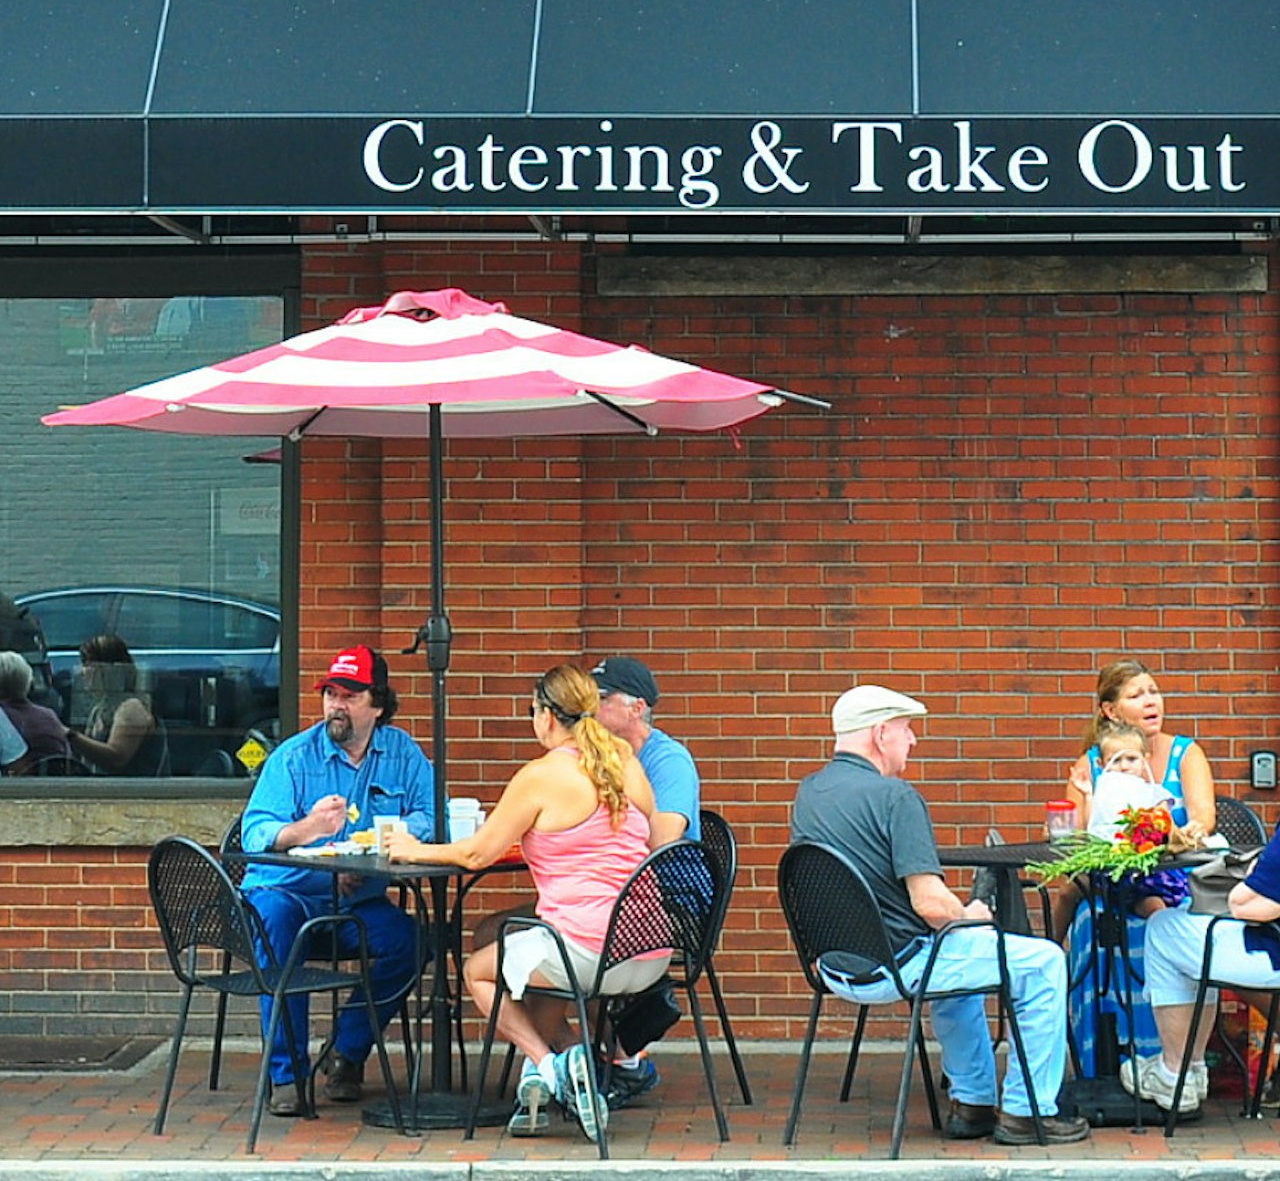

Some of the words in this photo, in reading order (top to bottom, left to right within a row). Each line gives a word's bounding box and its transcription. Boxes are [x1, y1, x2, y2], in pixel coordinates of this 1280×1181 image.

[363, 119, 722, 210] Catering
[743, 120, 810, 194] &
[832, 121, 1049, 192] Take
[1078, 119, 1246, 193] Out
